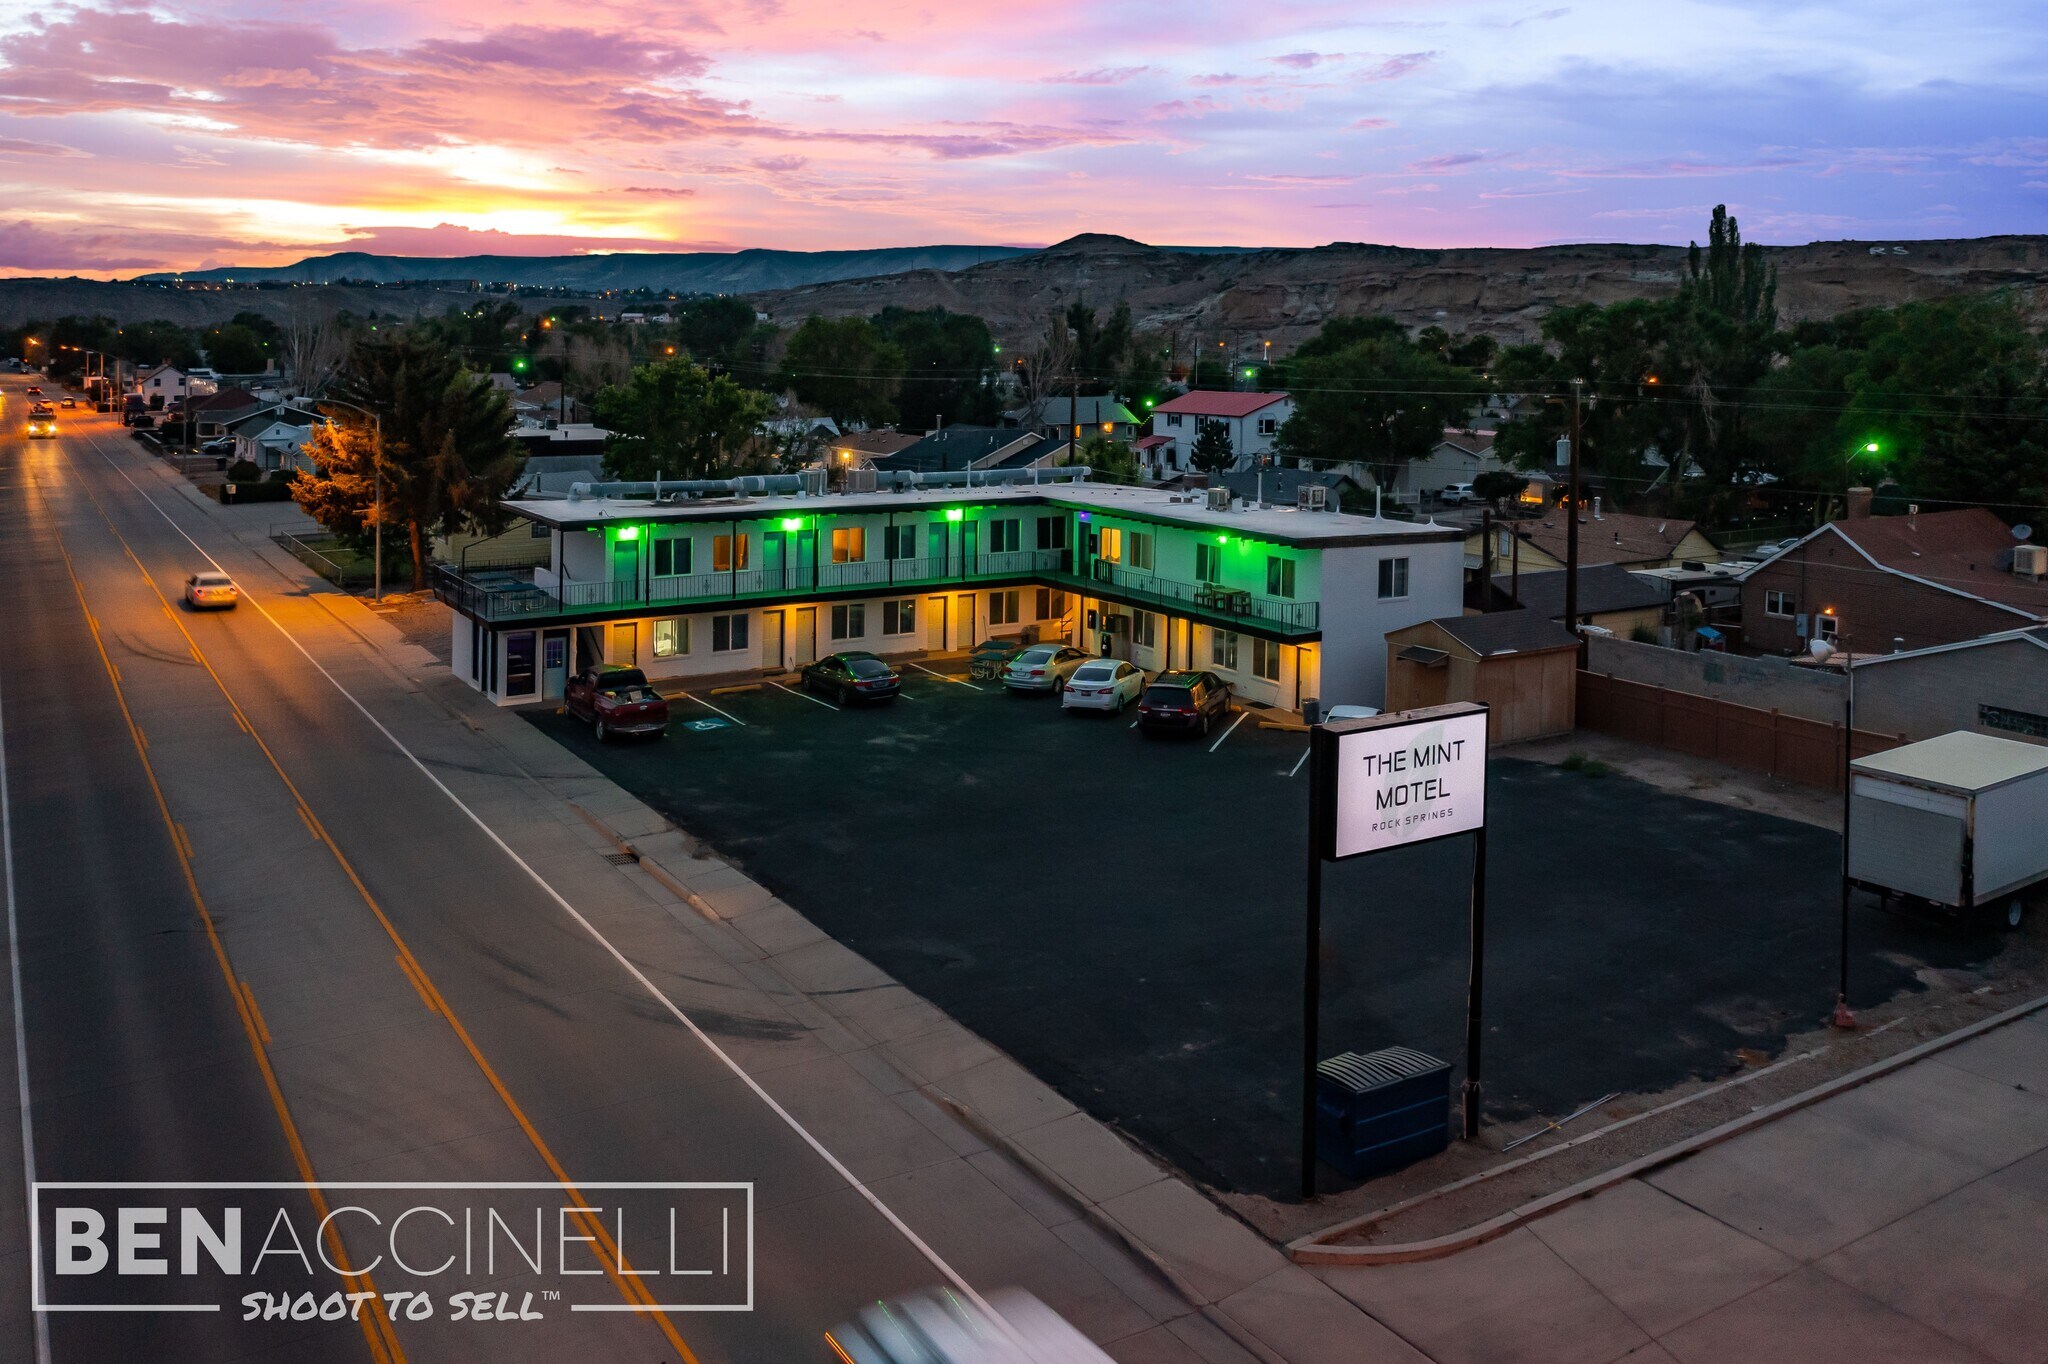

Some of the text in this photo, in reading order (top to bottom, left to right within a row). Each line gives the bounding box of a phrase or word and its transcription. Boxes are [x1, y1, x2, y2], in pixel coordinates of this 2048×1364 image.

[1363, 739, 1465, 776] THE MINT
[1376, 778, 1450, 810] MOTEL
[1371, 808, 1453, 831] ROCK SPRINGS
